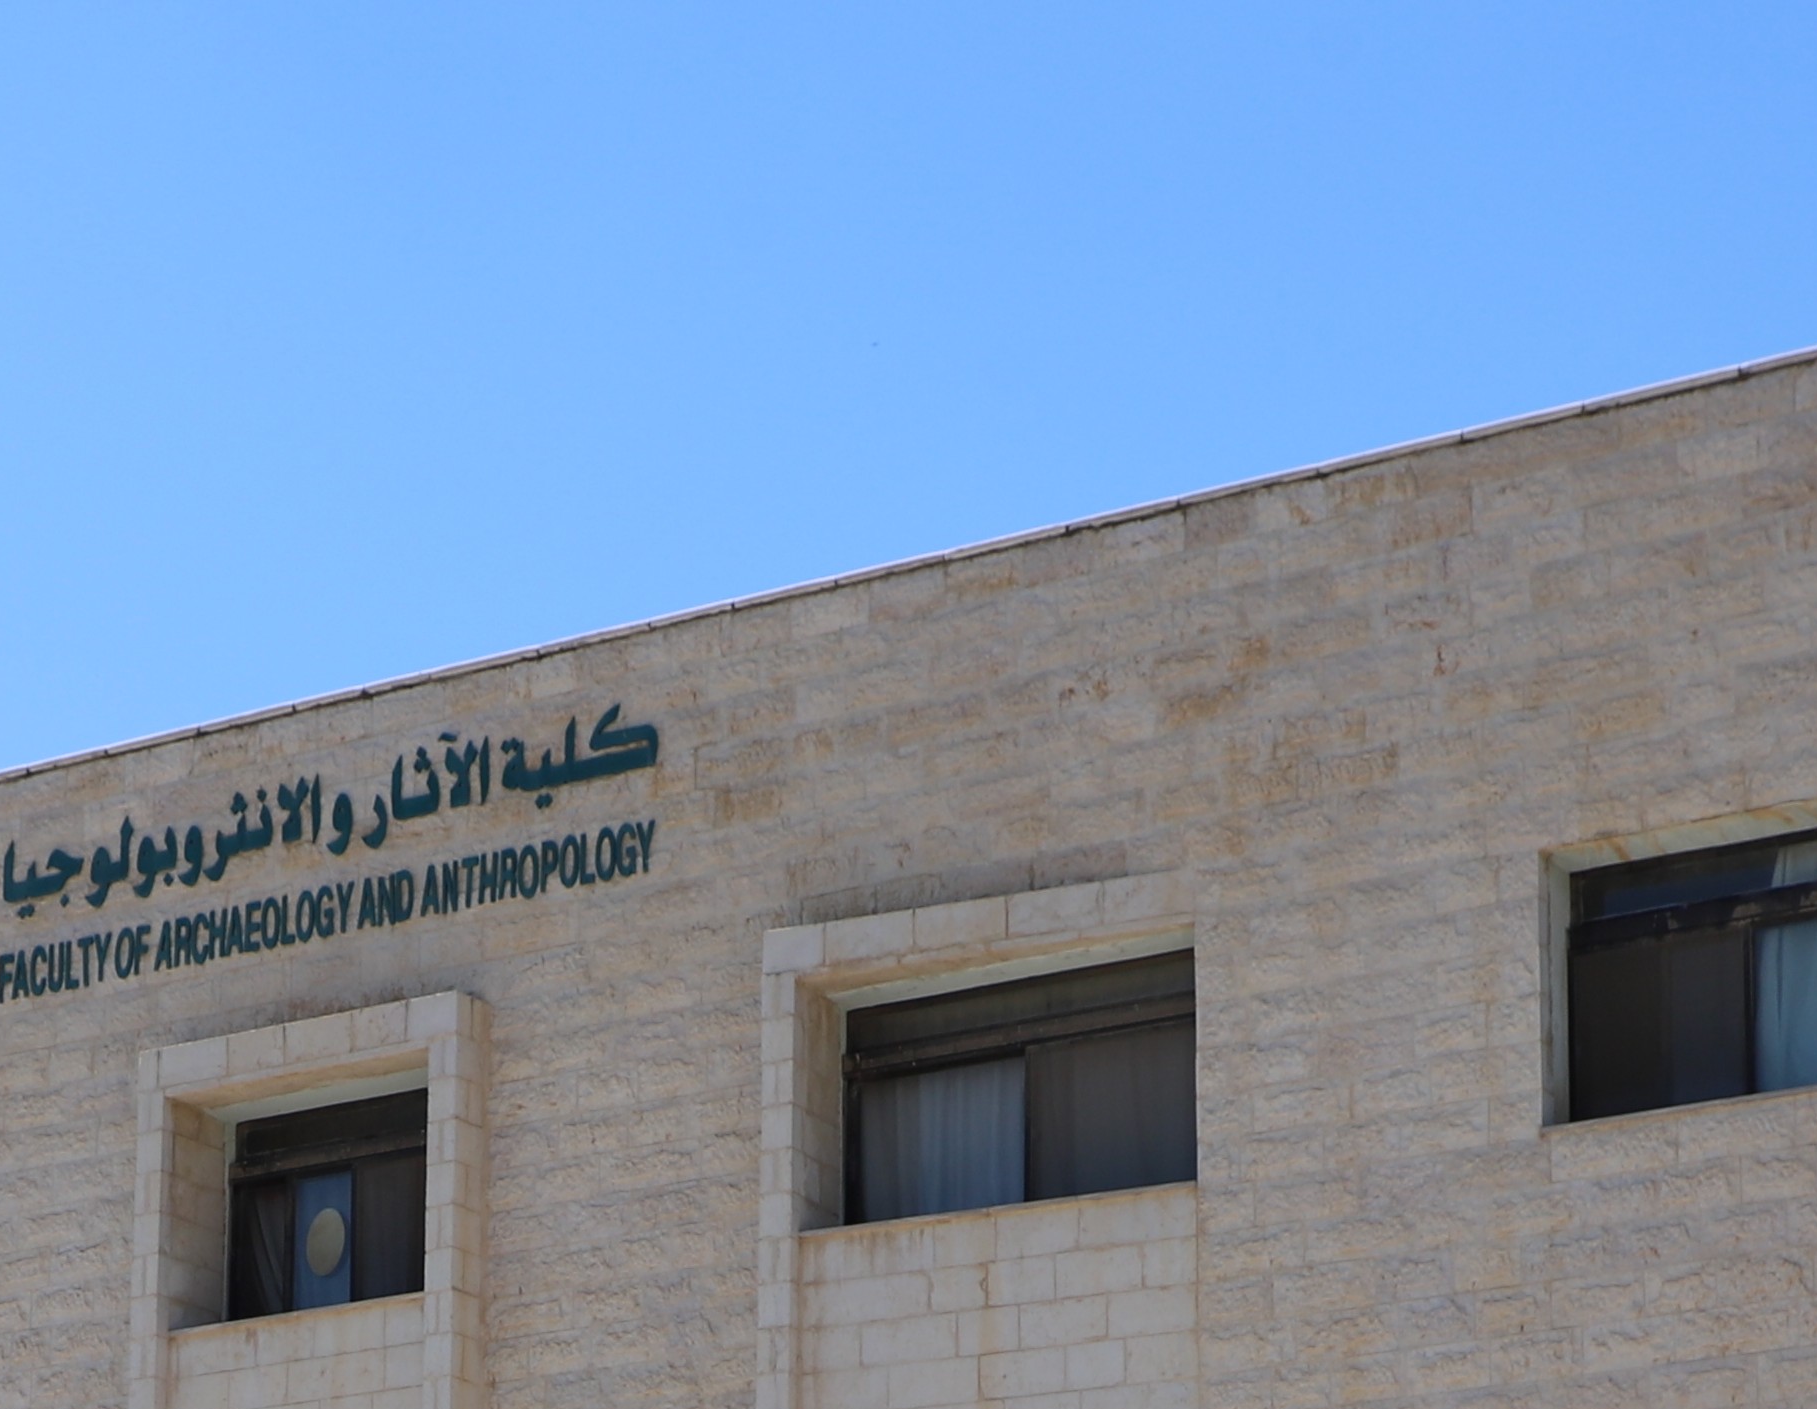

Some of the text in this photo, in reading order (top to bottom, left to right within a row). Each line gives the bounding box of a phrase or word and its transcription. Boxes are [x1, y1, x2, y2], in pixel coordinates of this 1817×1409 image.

[362, 732, 489, 849] الآثار
[501, 702, 659, 809] كلية
[114, 924, 151, 979] OF
[154, 882, 356, 971] ARCHAEOLOGY
[358, 869, 414, 930] AND
[421, 819, 656, 918] ANTHROPOLOGY
